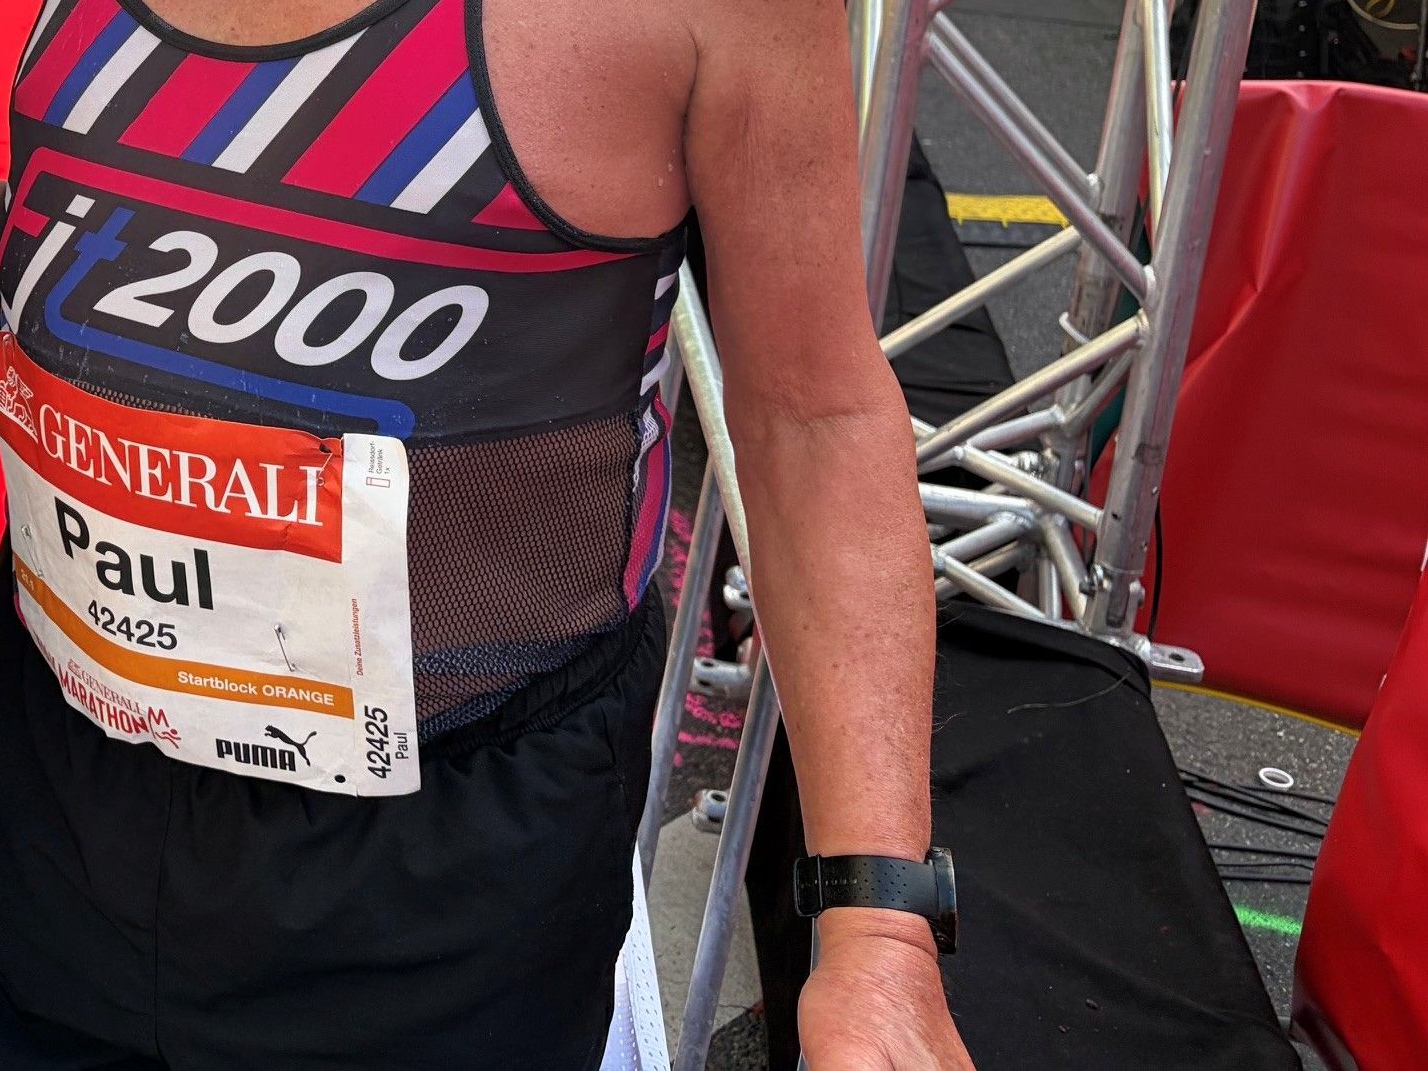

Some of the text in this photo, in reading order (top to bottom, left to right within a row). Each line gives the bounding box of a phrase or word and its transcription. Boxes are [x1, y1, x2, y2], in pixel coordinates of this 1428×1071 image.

[93, 230, 490, 381] 2000
[39, 403, 323, 527] GENERALI
[53, 496, 214, 610] Paul
[88, 599, 178, 650] 42425
[351, 598, 364, 676] Deine Zusatzleistungen
[58, 669, 149, 735] MARATHON
[81, 670, 144, 715] GENERALI
[177, 670, 335, 706] Startblock ORANGE
[216, 737, 297, 771] PUMA
[364, 705, 392, 779] 42425
[394, 732, 409, 760] Paul
